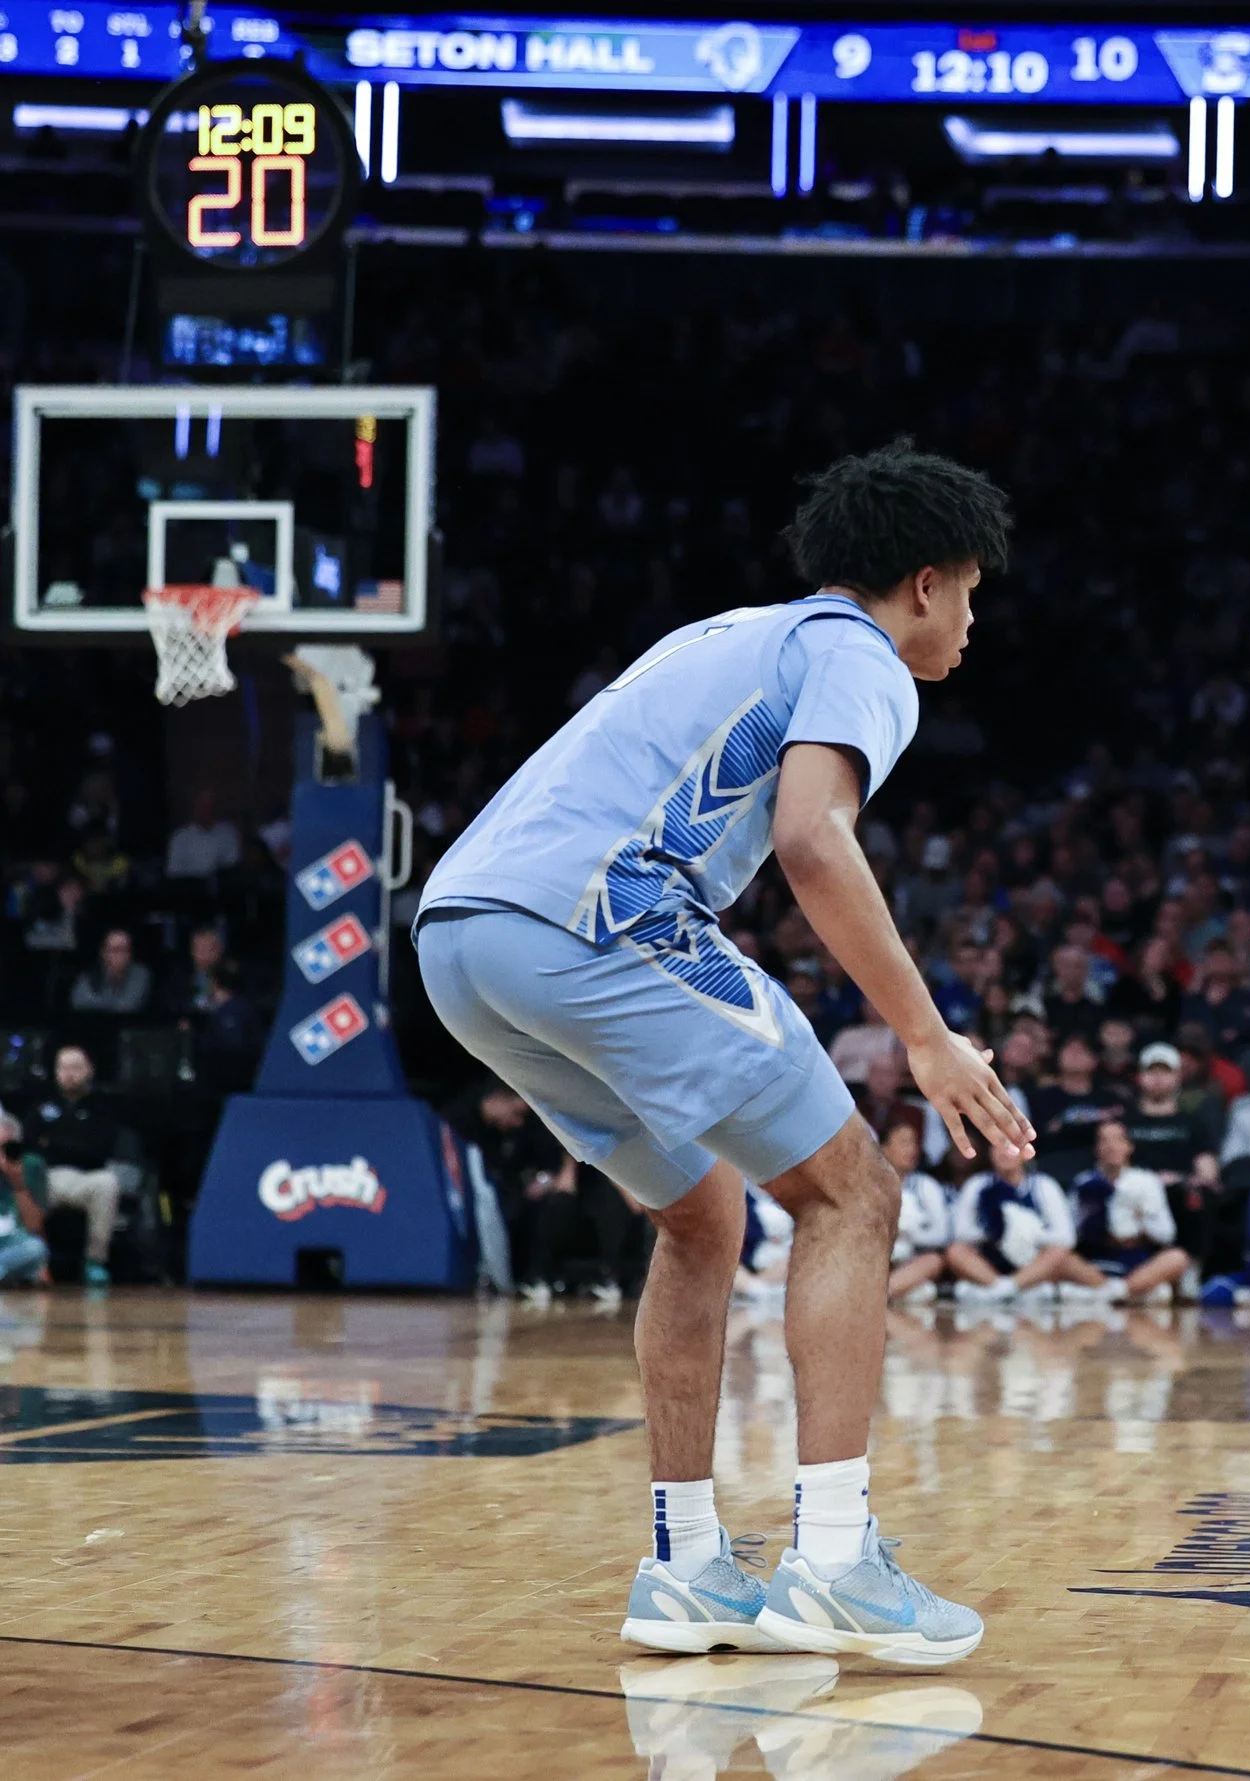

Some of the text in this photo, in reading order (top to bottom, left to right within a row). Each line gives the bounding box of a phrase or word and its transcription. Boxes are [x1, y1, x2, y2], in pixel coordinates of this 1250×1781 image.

[346, 28, 655, 72] SETON HALL
[832, 34, 873, 79] 9
[911, 49, 1049, 94] 12:10
[1069, 35, 1139, 82] 10
[198, 103, 315, 155] 12:09
[188, 155, 305, 247] 20
[258, 1156, 386, 1220] Crush
